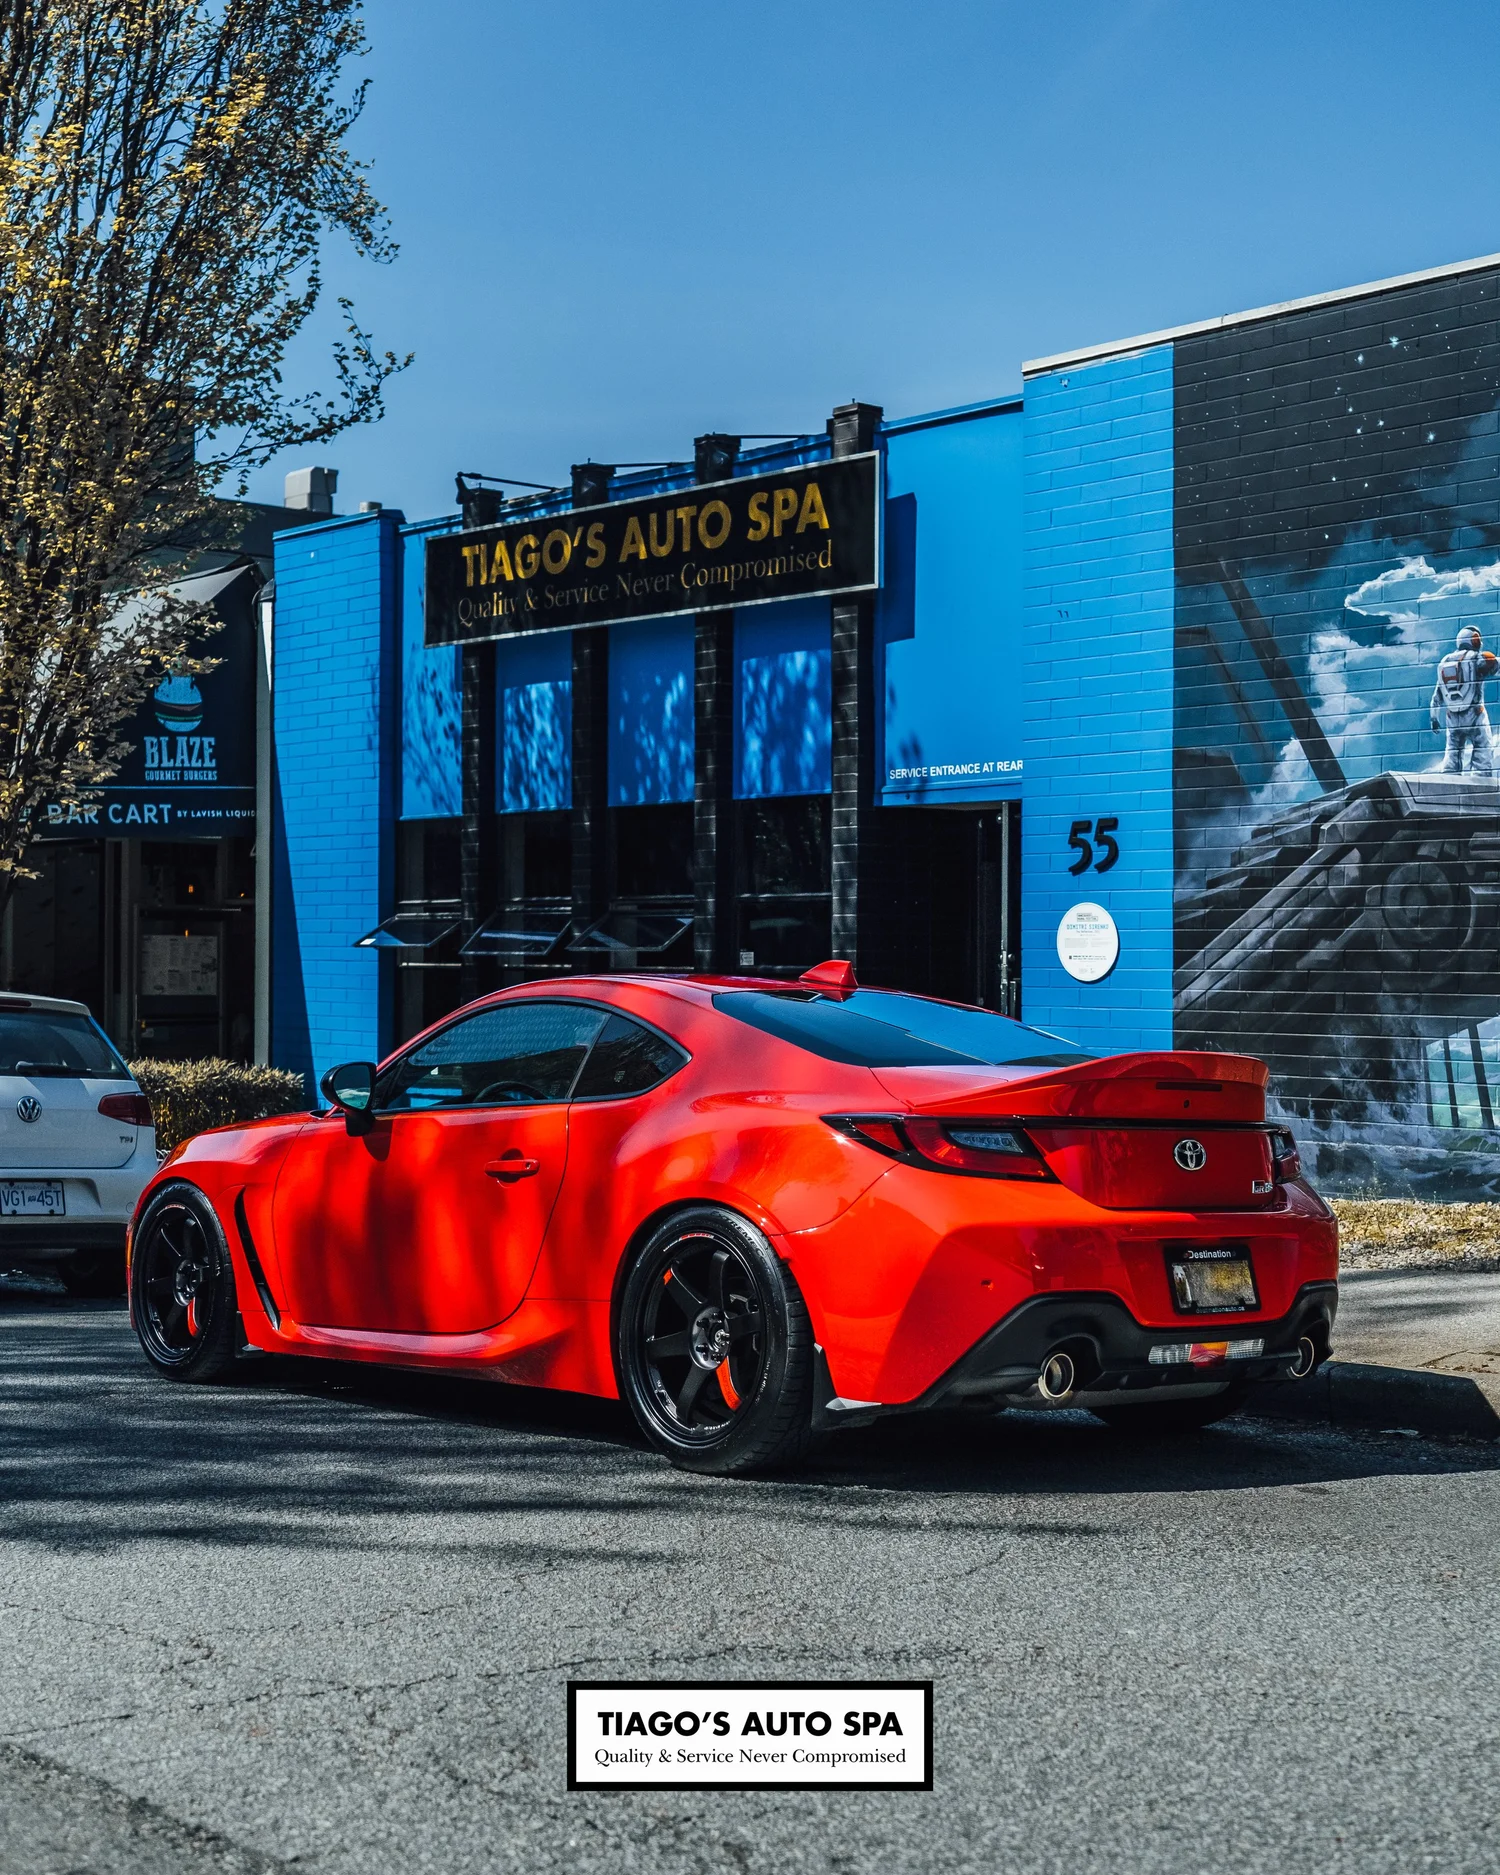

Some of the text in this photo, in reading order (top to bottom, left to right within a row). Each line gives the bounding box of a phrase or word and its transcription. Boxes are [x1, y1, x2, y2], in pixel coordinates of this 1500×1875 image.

[461, 482, 830, 587] TIAGO'S AUTO SPA
[458, 539, 833, 628] Quality & Service Never Compromised
[143, 736, 217, 768] BLAZE
[145, 770, 218, 781] GOURMET BURGERS
[889, 759, 1023, 780] SERVICE ENTRANCE AT REAR
[47, 804, 99, 824] BAR
[108, 804, 172, 824] CART
[176, 809, 188, 818] BY
[191, 809, 223, 818] LAVISH
[1067, 817, 1119, 877] 55
[1, 1190, 61, 1207] VG1 45T
[1187, 1249, 1232, 1259] Destination
